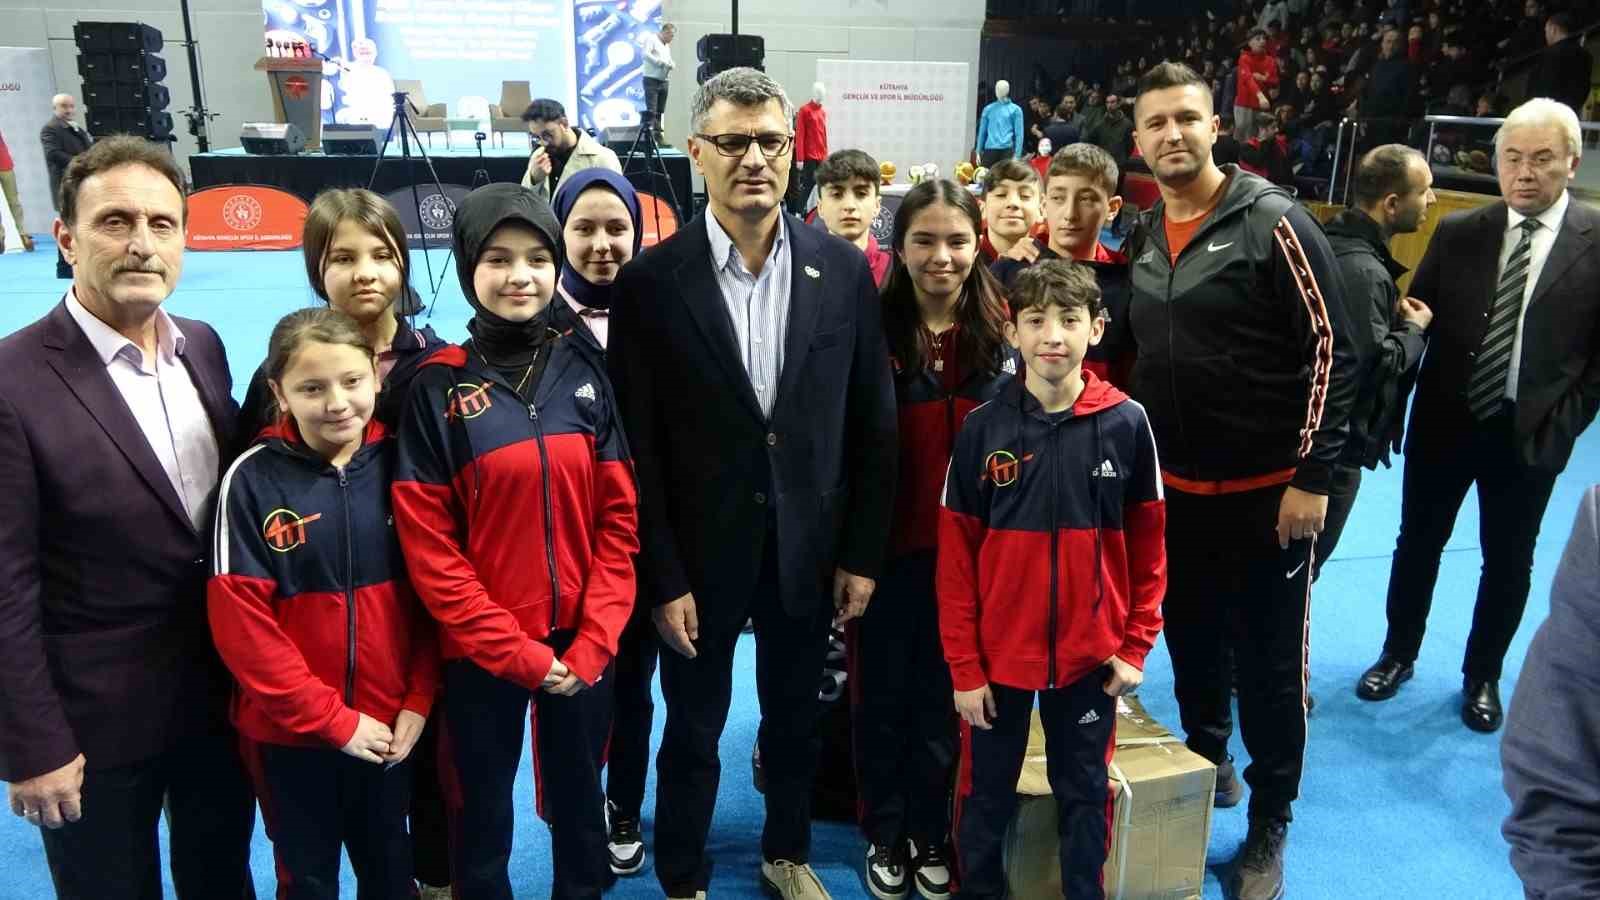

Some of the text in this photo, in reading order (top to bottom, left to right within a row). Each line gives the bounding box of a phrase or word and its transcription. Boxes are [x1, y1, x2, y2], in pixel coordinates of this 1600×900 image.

[879, 82, 908, 91] KÜTAHYA
[842, 93, 869, 101] GENÇLİK
[880, 93, 896, 101] SPOR
